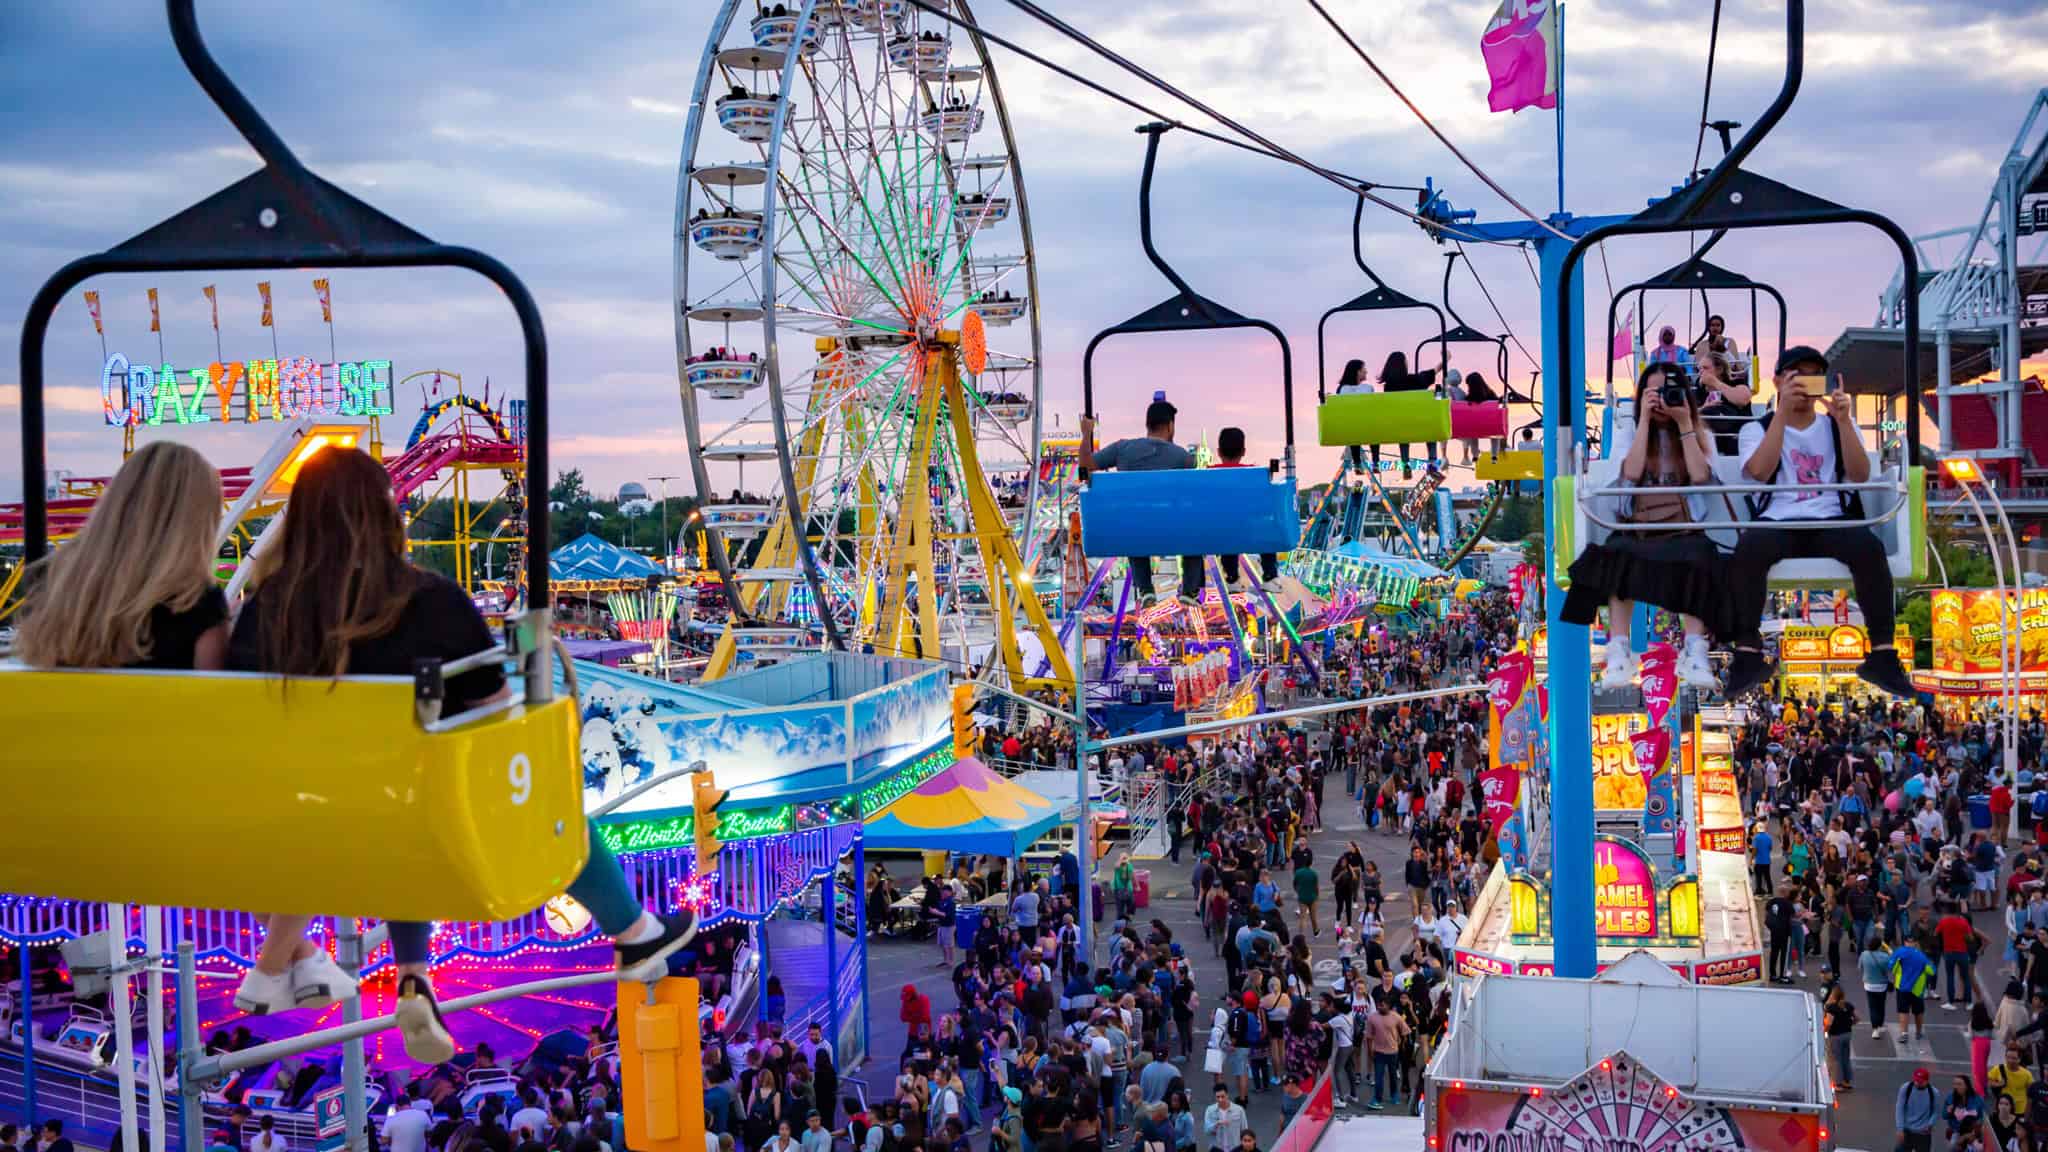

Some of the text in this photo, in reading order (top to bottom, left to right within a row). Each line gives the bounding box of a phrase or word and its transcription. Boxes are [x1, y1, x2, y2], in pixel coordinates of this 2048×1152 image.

[1788, 629, 1826, 637] COFFEE
[508, 752, 531, 806] 9
[1466, 955, 1502, 977] COLD
[1706, 960, 1749, 977] COLD
[329, 1099, 338, 1115] 6
